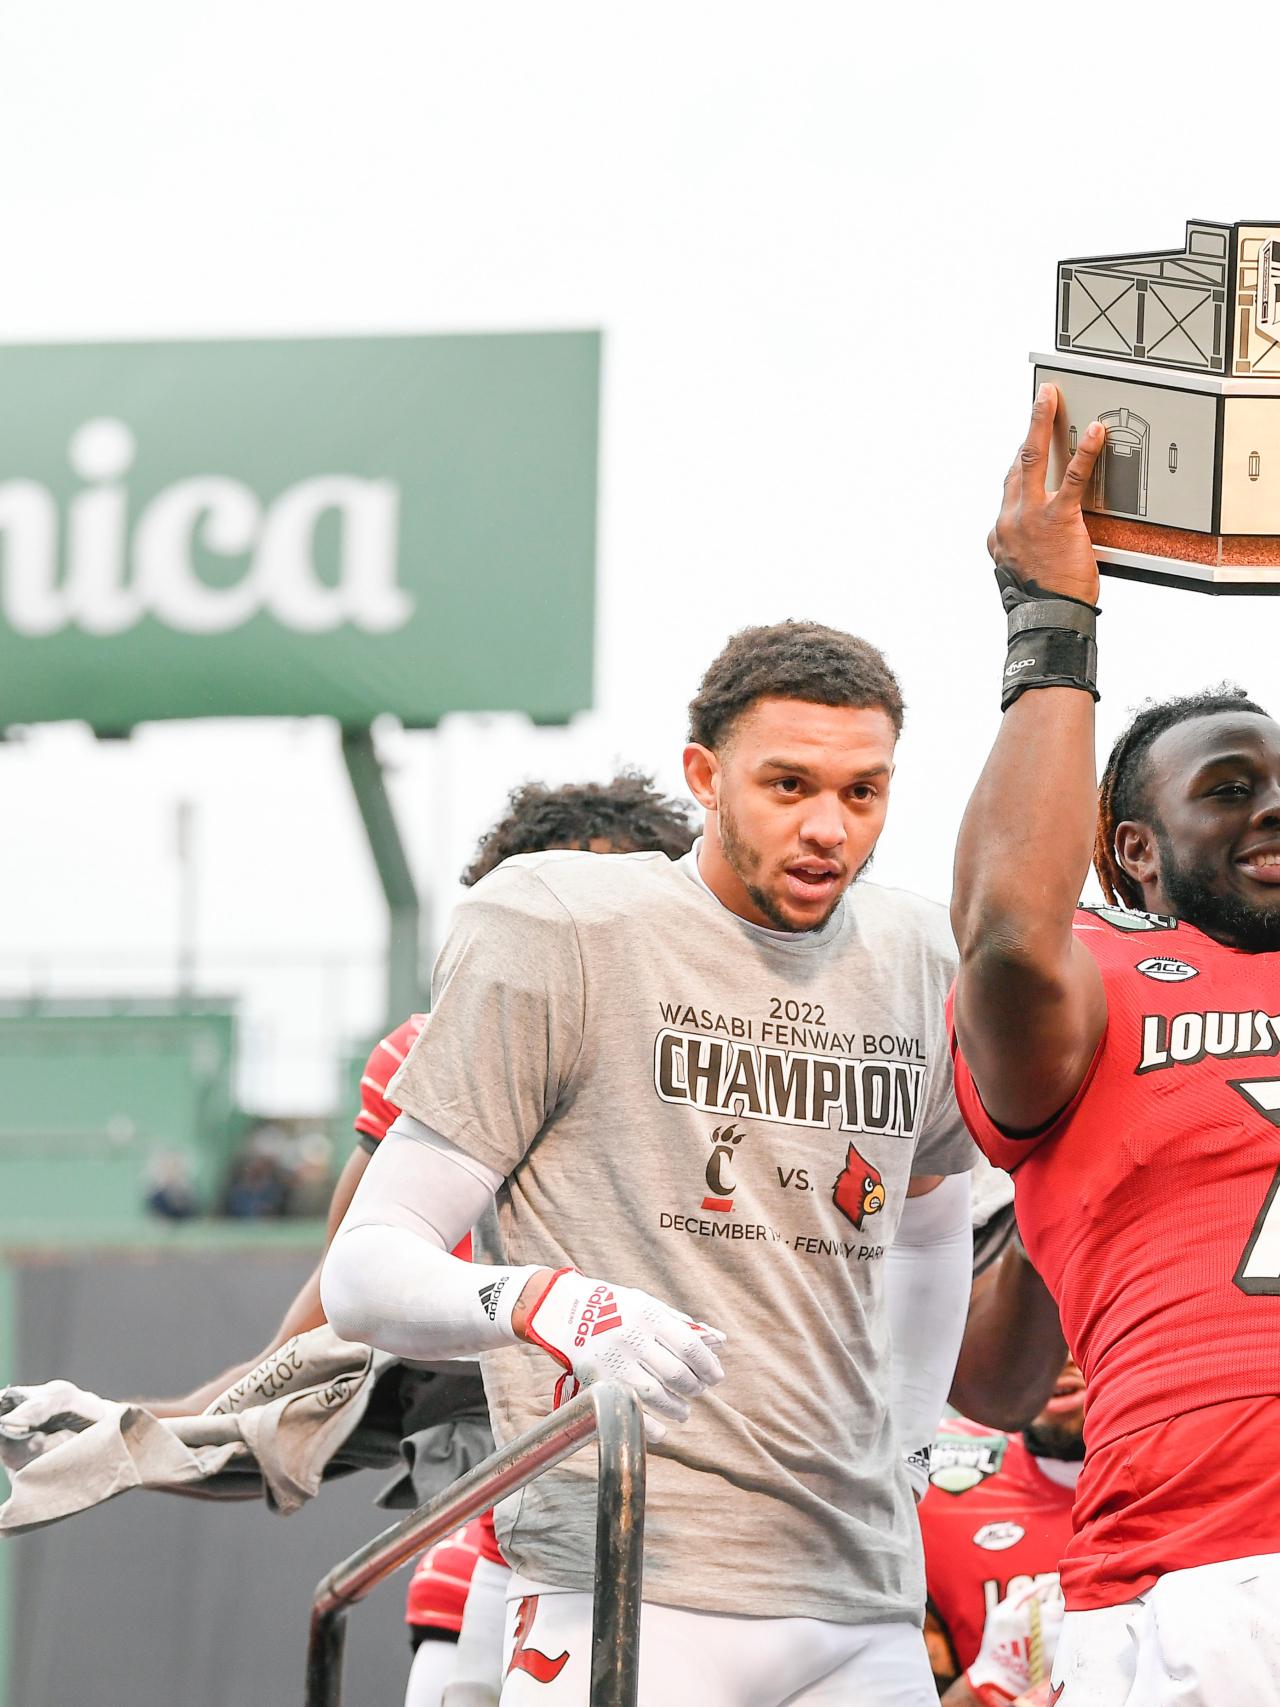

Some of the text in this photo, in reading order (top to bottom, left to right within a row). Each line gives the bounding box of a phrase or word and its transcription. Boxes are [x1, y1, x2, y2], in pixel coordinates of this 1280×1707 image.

[1145, 962, 1188, 974] ACC
[659, 1001, 926, 1060] WASABI FENWAY BOWL
[768, 997, 827, 1026] 2022
[656, 1029, 926, 1136] CHAMPION
[776, 1166, 815, 1192] VS.
[660, 1212, 766, 1241] DECEMBER
[488, 1276, 510, 1322] adidas
[574, 1285, 608, 1348] adidas
[254, 1350, 303, 1398] 2022
